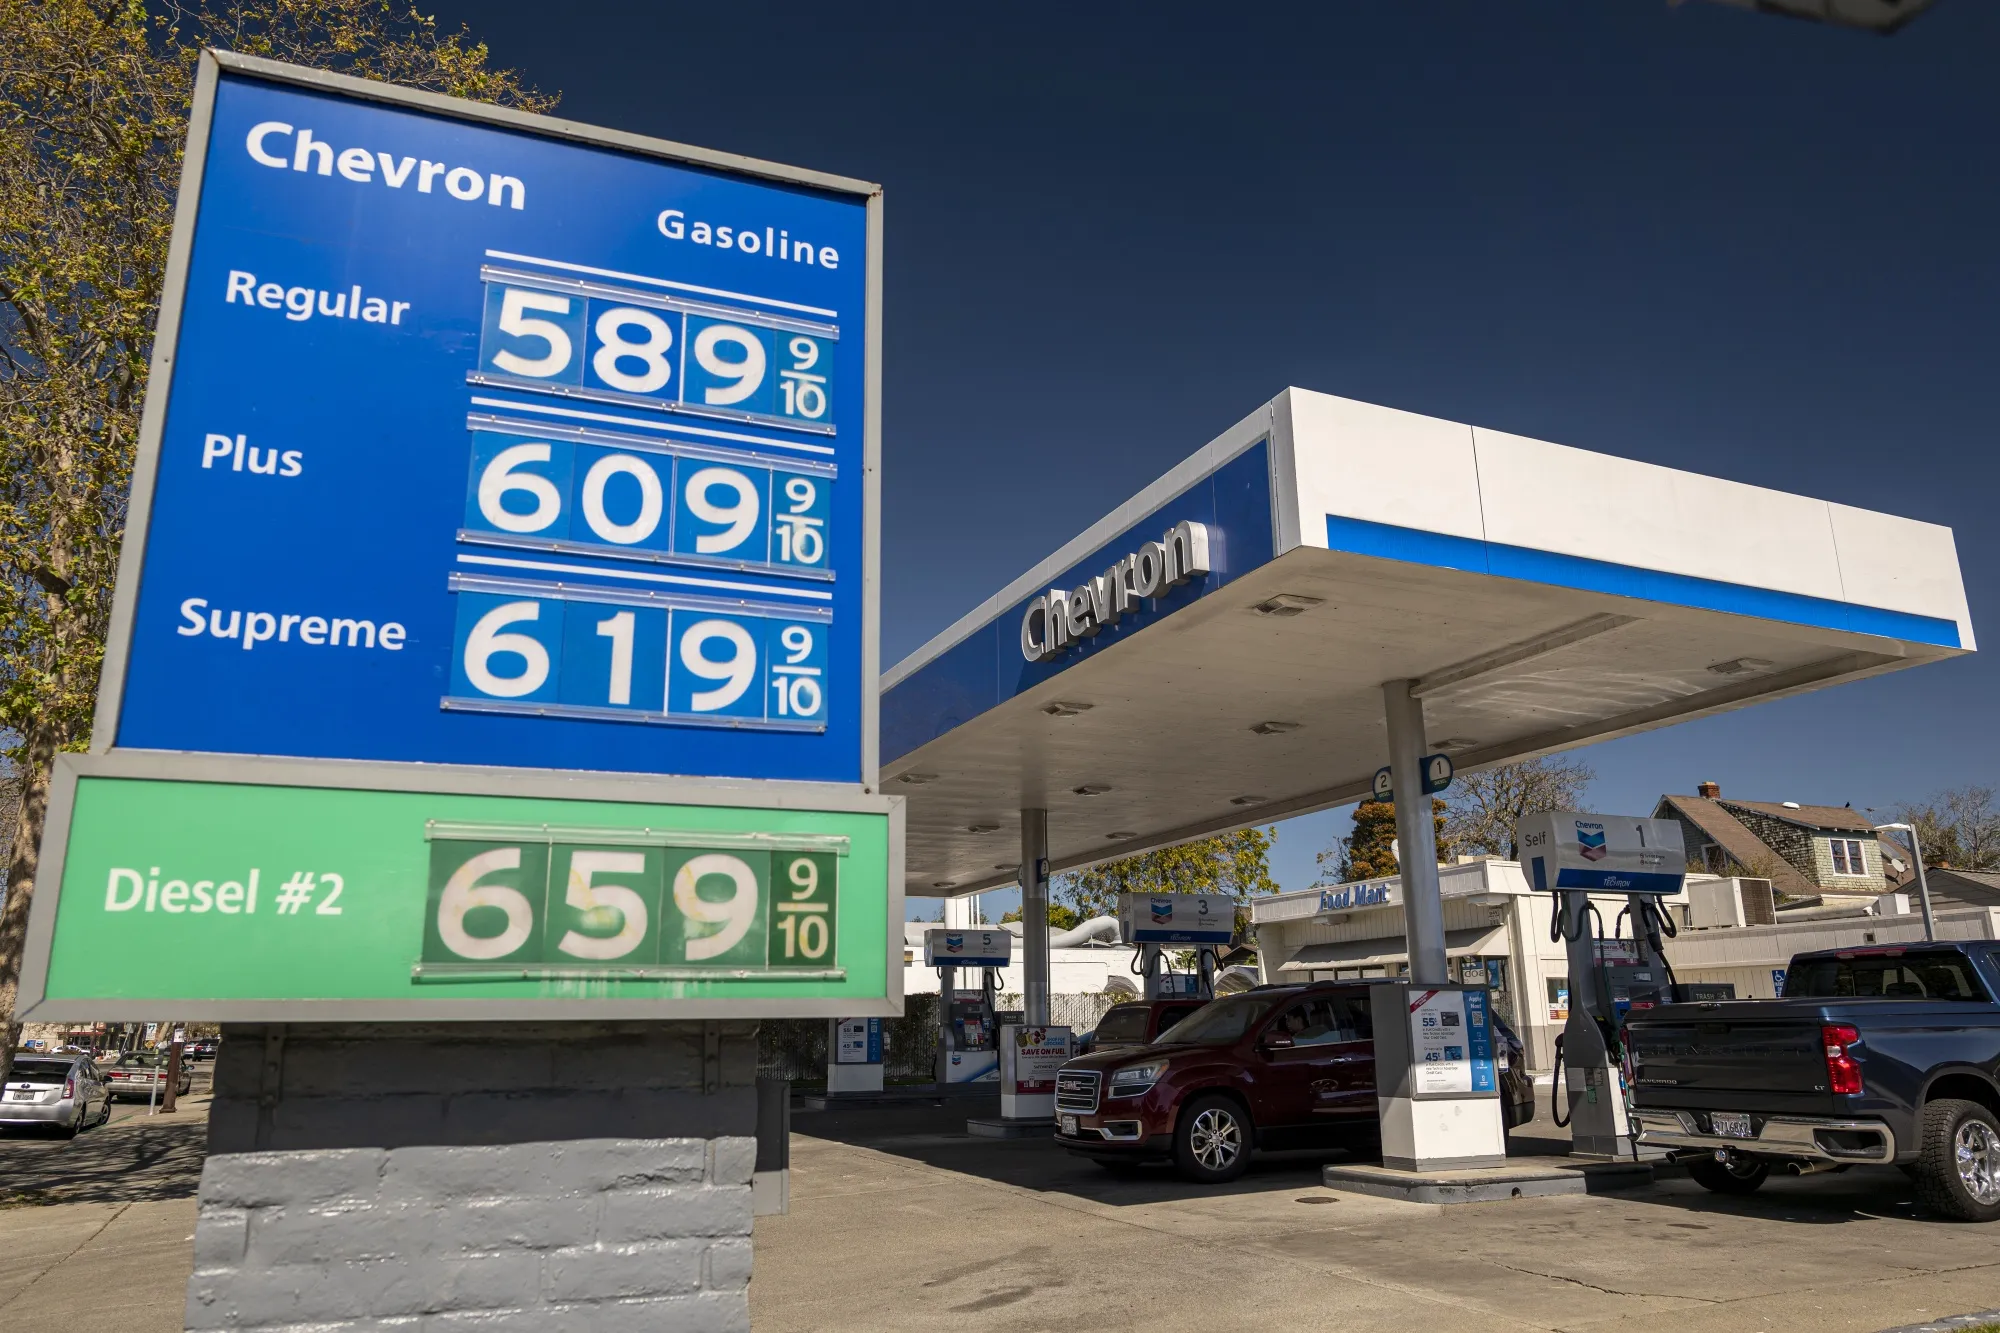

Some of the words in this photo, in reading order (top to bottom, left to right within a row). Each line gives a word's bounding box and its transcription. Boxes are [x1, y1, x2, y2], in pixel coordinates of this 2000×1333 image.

[246, 121, 526, 211] Chevron
[657, 209, 839, 269] Gasoline
[226, 270, 411, 325] Regular
[492, 288, 767, 405] 589
[202, 433, 304, 477] Plus
[478, 443, 760, 554] 609
[1021, 520, 1210, 662] Chevron
[177, 598, 407, 650] Supreme
[464, 601, 757, 711] 619
[1380, 774, 1388, 789] 2
[1436, 760, 1442, 775] 1
[1524, 831, 1546, 847] Self
[1575, 820, 1604, 830] Chevron
[1635, 824, 1646, 847] 1
[104, 866, 261, 914] Diesel
[274, 871, 345, 916] #2
[1319, 886, 1351, 911] Food
[1354, 883, 1388, 905] Mart
[1603, 878, 1631, 888] TECHRON
[437, 847, 758, 961] 659
[1198, 899, 1209, 915] 3
[983, 933, 992, 946] 5
[1021, 1048, 1040, 1056] SAVE
[1063, 1080, 1082, 1090] GMC
